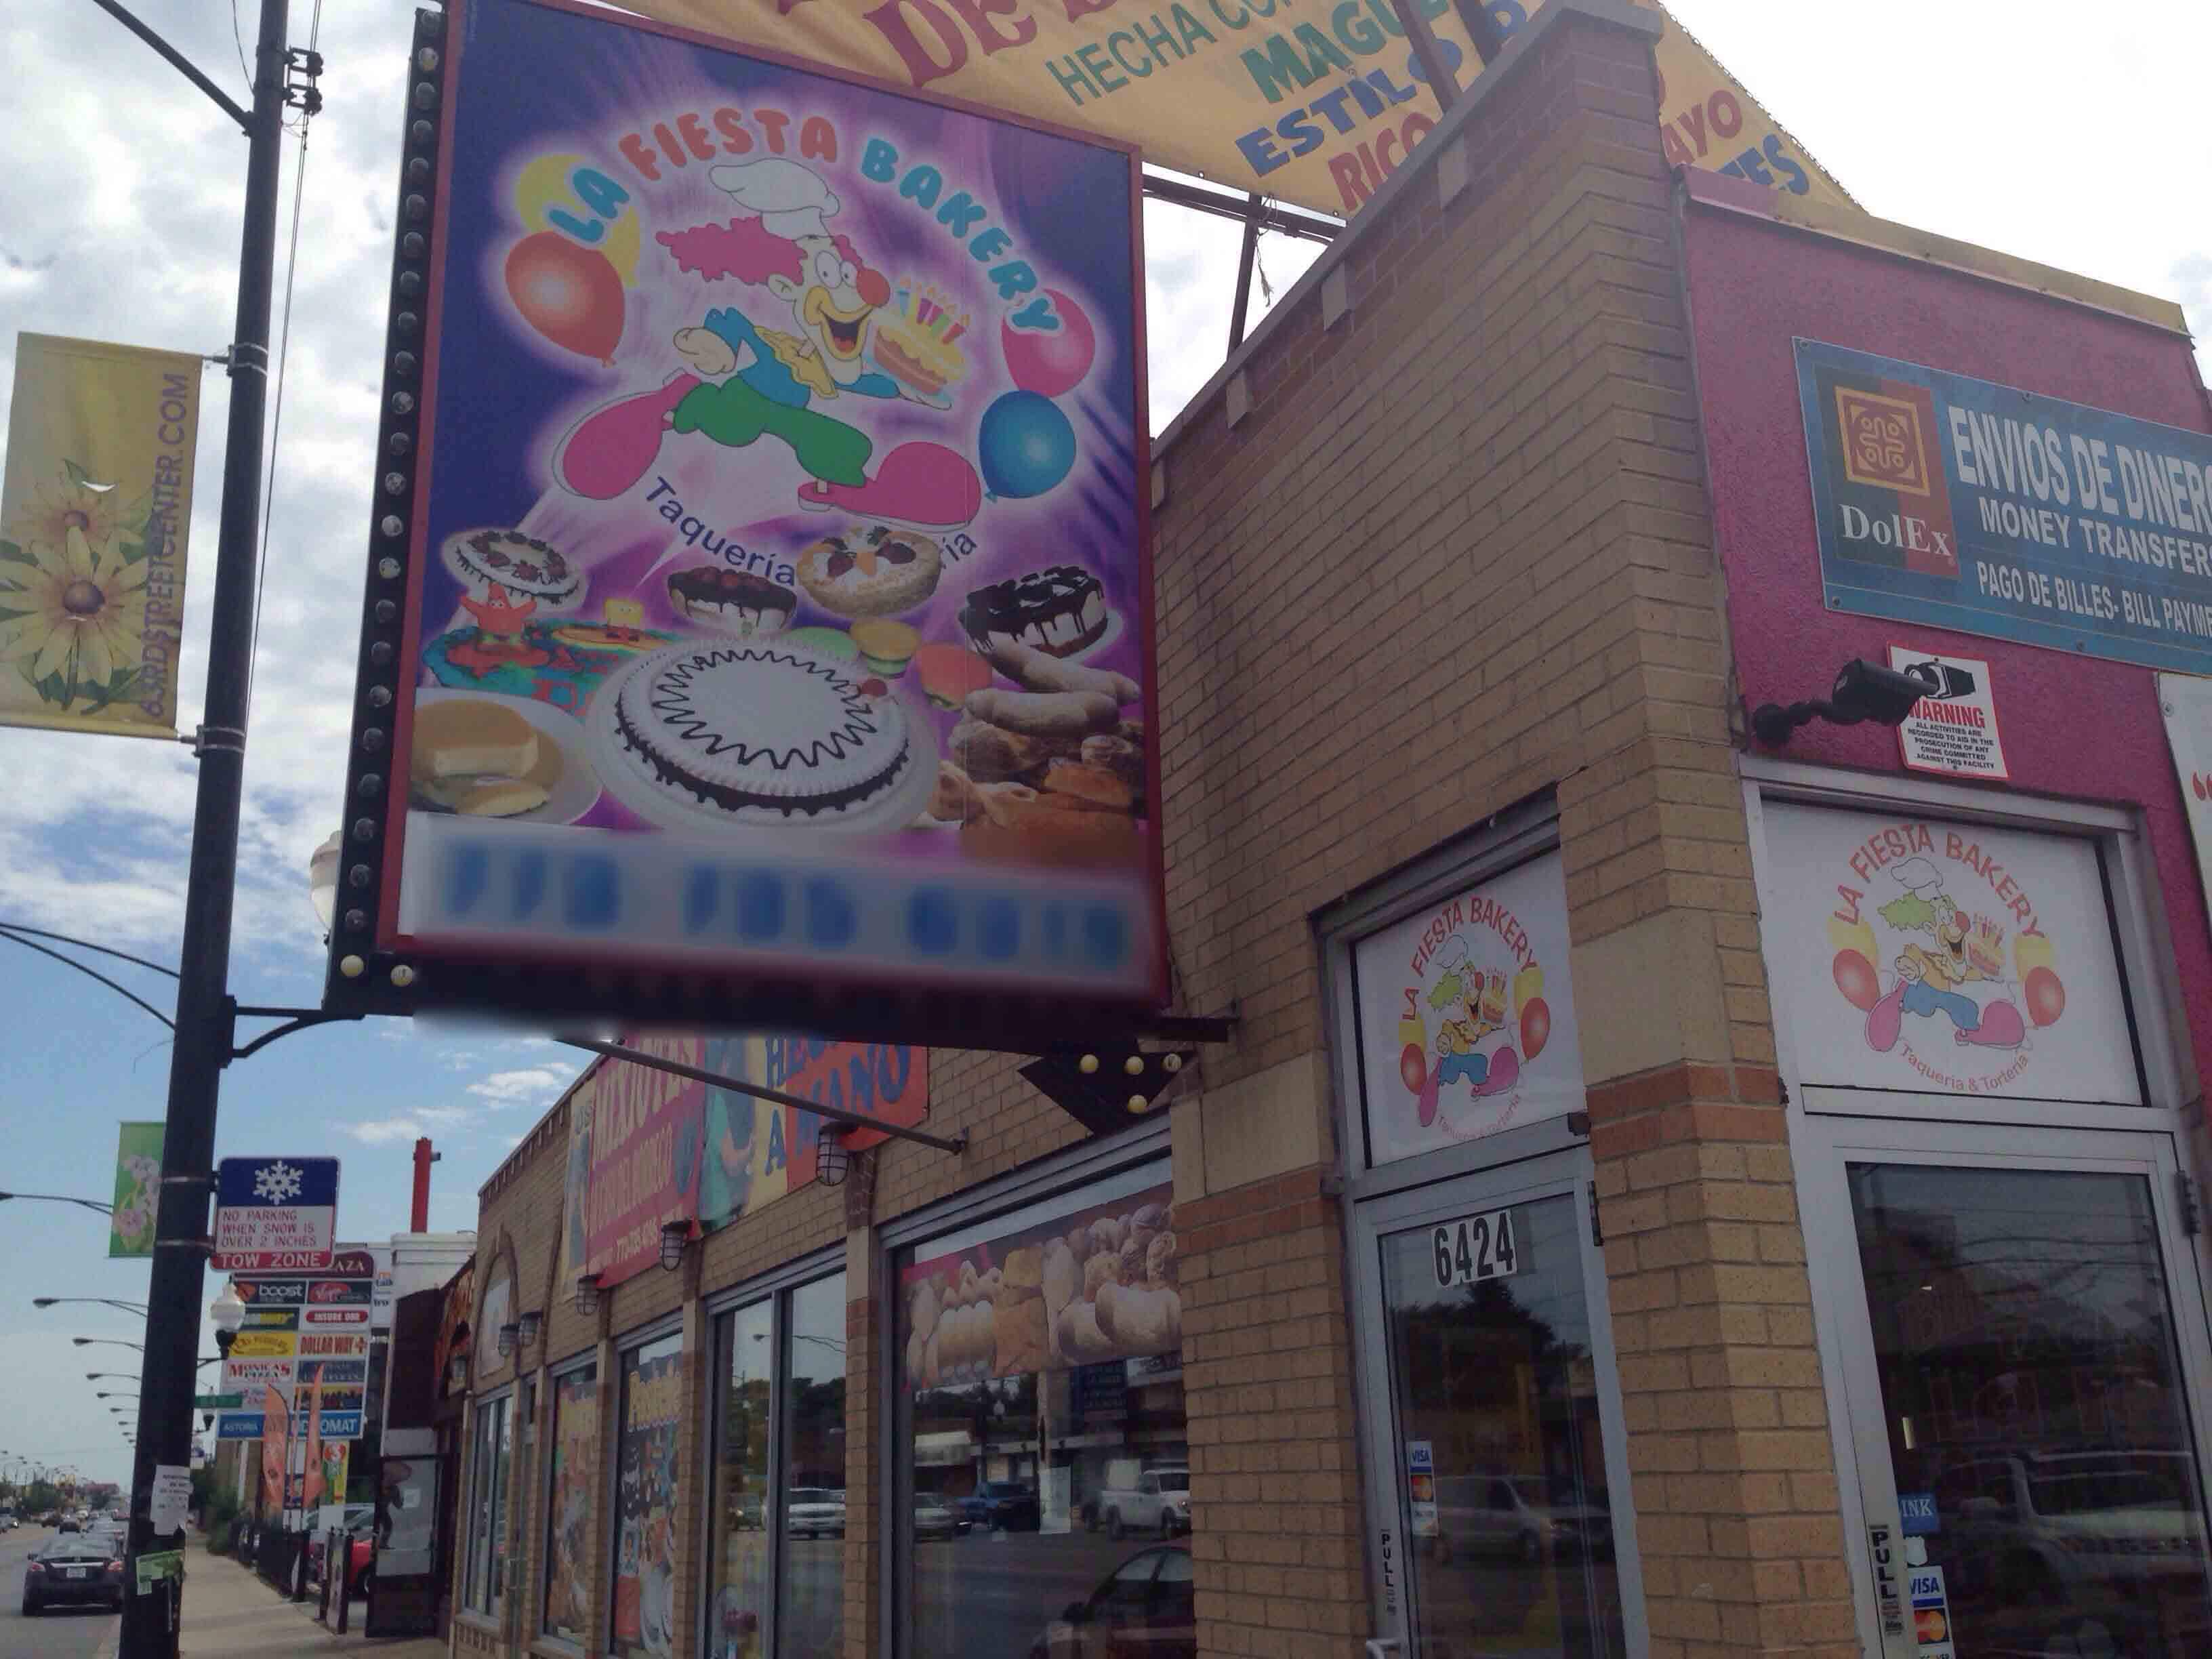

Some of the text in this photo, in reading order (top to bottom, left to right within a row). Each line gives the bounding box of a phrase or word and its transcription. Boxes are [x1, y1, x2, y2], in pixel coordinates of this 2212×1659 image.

[1044, 3, 1218, 106] HECHA
[548, 108, 1061, 332] LA FIESTA BAKERY
[1948, 406, 2070, 506] ENVIOS
[2070, 433, 2119, 515] DE
[1839, 504, 1953, 557] DolEx
[1978, 496, 2212, 577] MONEY TRANSFER
[1976, 561, 2025, 602] PAGO
[2027, 571, 2053, 609] DE
[2121, 590, 2161, 630] BILL
[1908, 700, 1986, 729] WARNING
[1908, 728, 1994, 747] RECORDED TO AID IN THE
[1916, 722, 1983, 737] ALL ACTIVITIES ARE
[1914, 737, 1963, 750] PROSECUTION
[1975, 745, 1989, 754] ANY
[1921, 746, 1986, 761] CRIME COMMITTED
[1917, 754, 1994, 769] AGAINST THIS FACILITY
[1834, 823, 2045, 939] LA FIESTA BAKERY
[1402, 895, 1538, 1020] LA FIESTA BAKERY
[222, 1209, 298, 1221] NO PARKING
[222, 1223, 315, 1234] WHEN SNOW IS
[222, 1235, 317, 1248] OVER 2 INCHES
[1433, 1211, 1514, 1287] 6424
[220, 1252, 321, 1269] TOW ZONE
[259, 1283, 304, 1296] boost
[1412, 1448, 1432, 1463] VISA
[1901, 1498, 1933, 1517] INK
[1381, 1533, 1395, 1586] PULL
[1872, 1531, 1897, 1599] PULL
[1910, 1577, 1940, 1594] VISA
